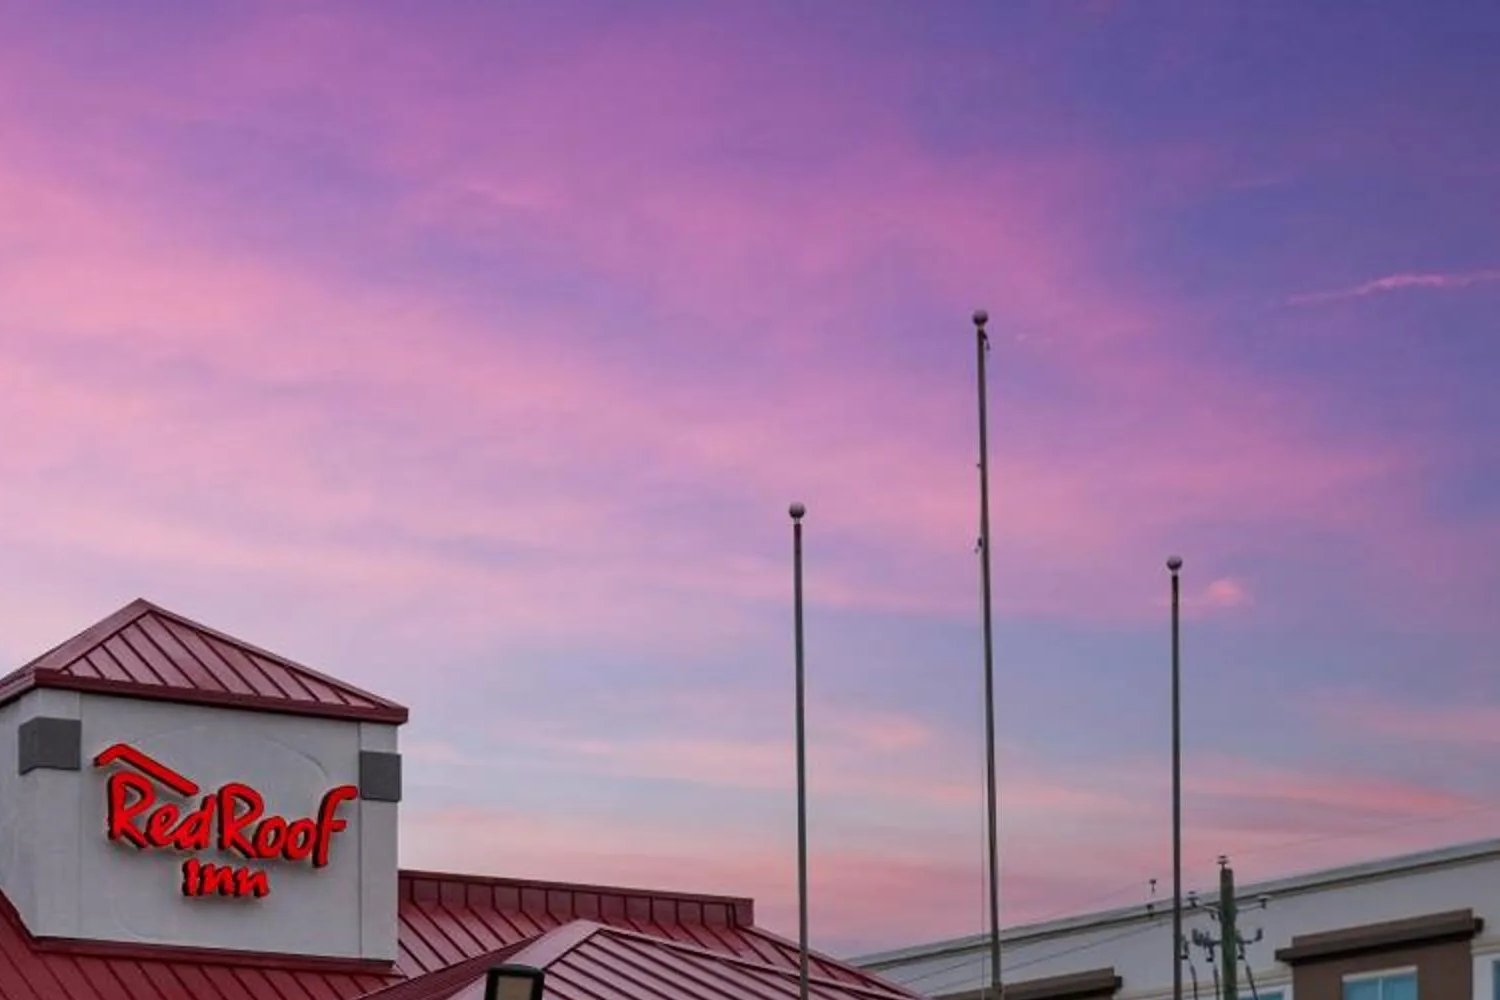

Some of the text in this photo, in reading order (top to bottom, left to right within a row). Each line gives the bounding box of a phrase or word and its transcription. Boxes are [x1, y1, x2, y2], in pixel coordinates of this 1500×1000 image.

[108, 771, 357, 867] Red Roof
[182, 858, 270, 897] Inn
